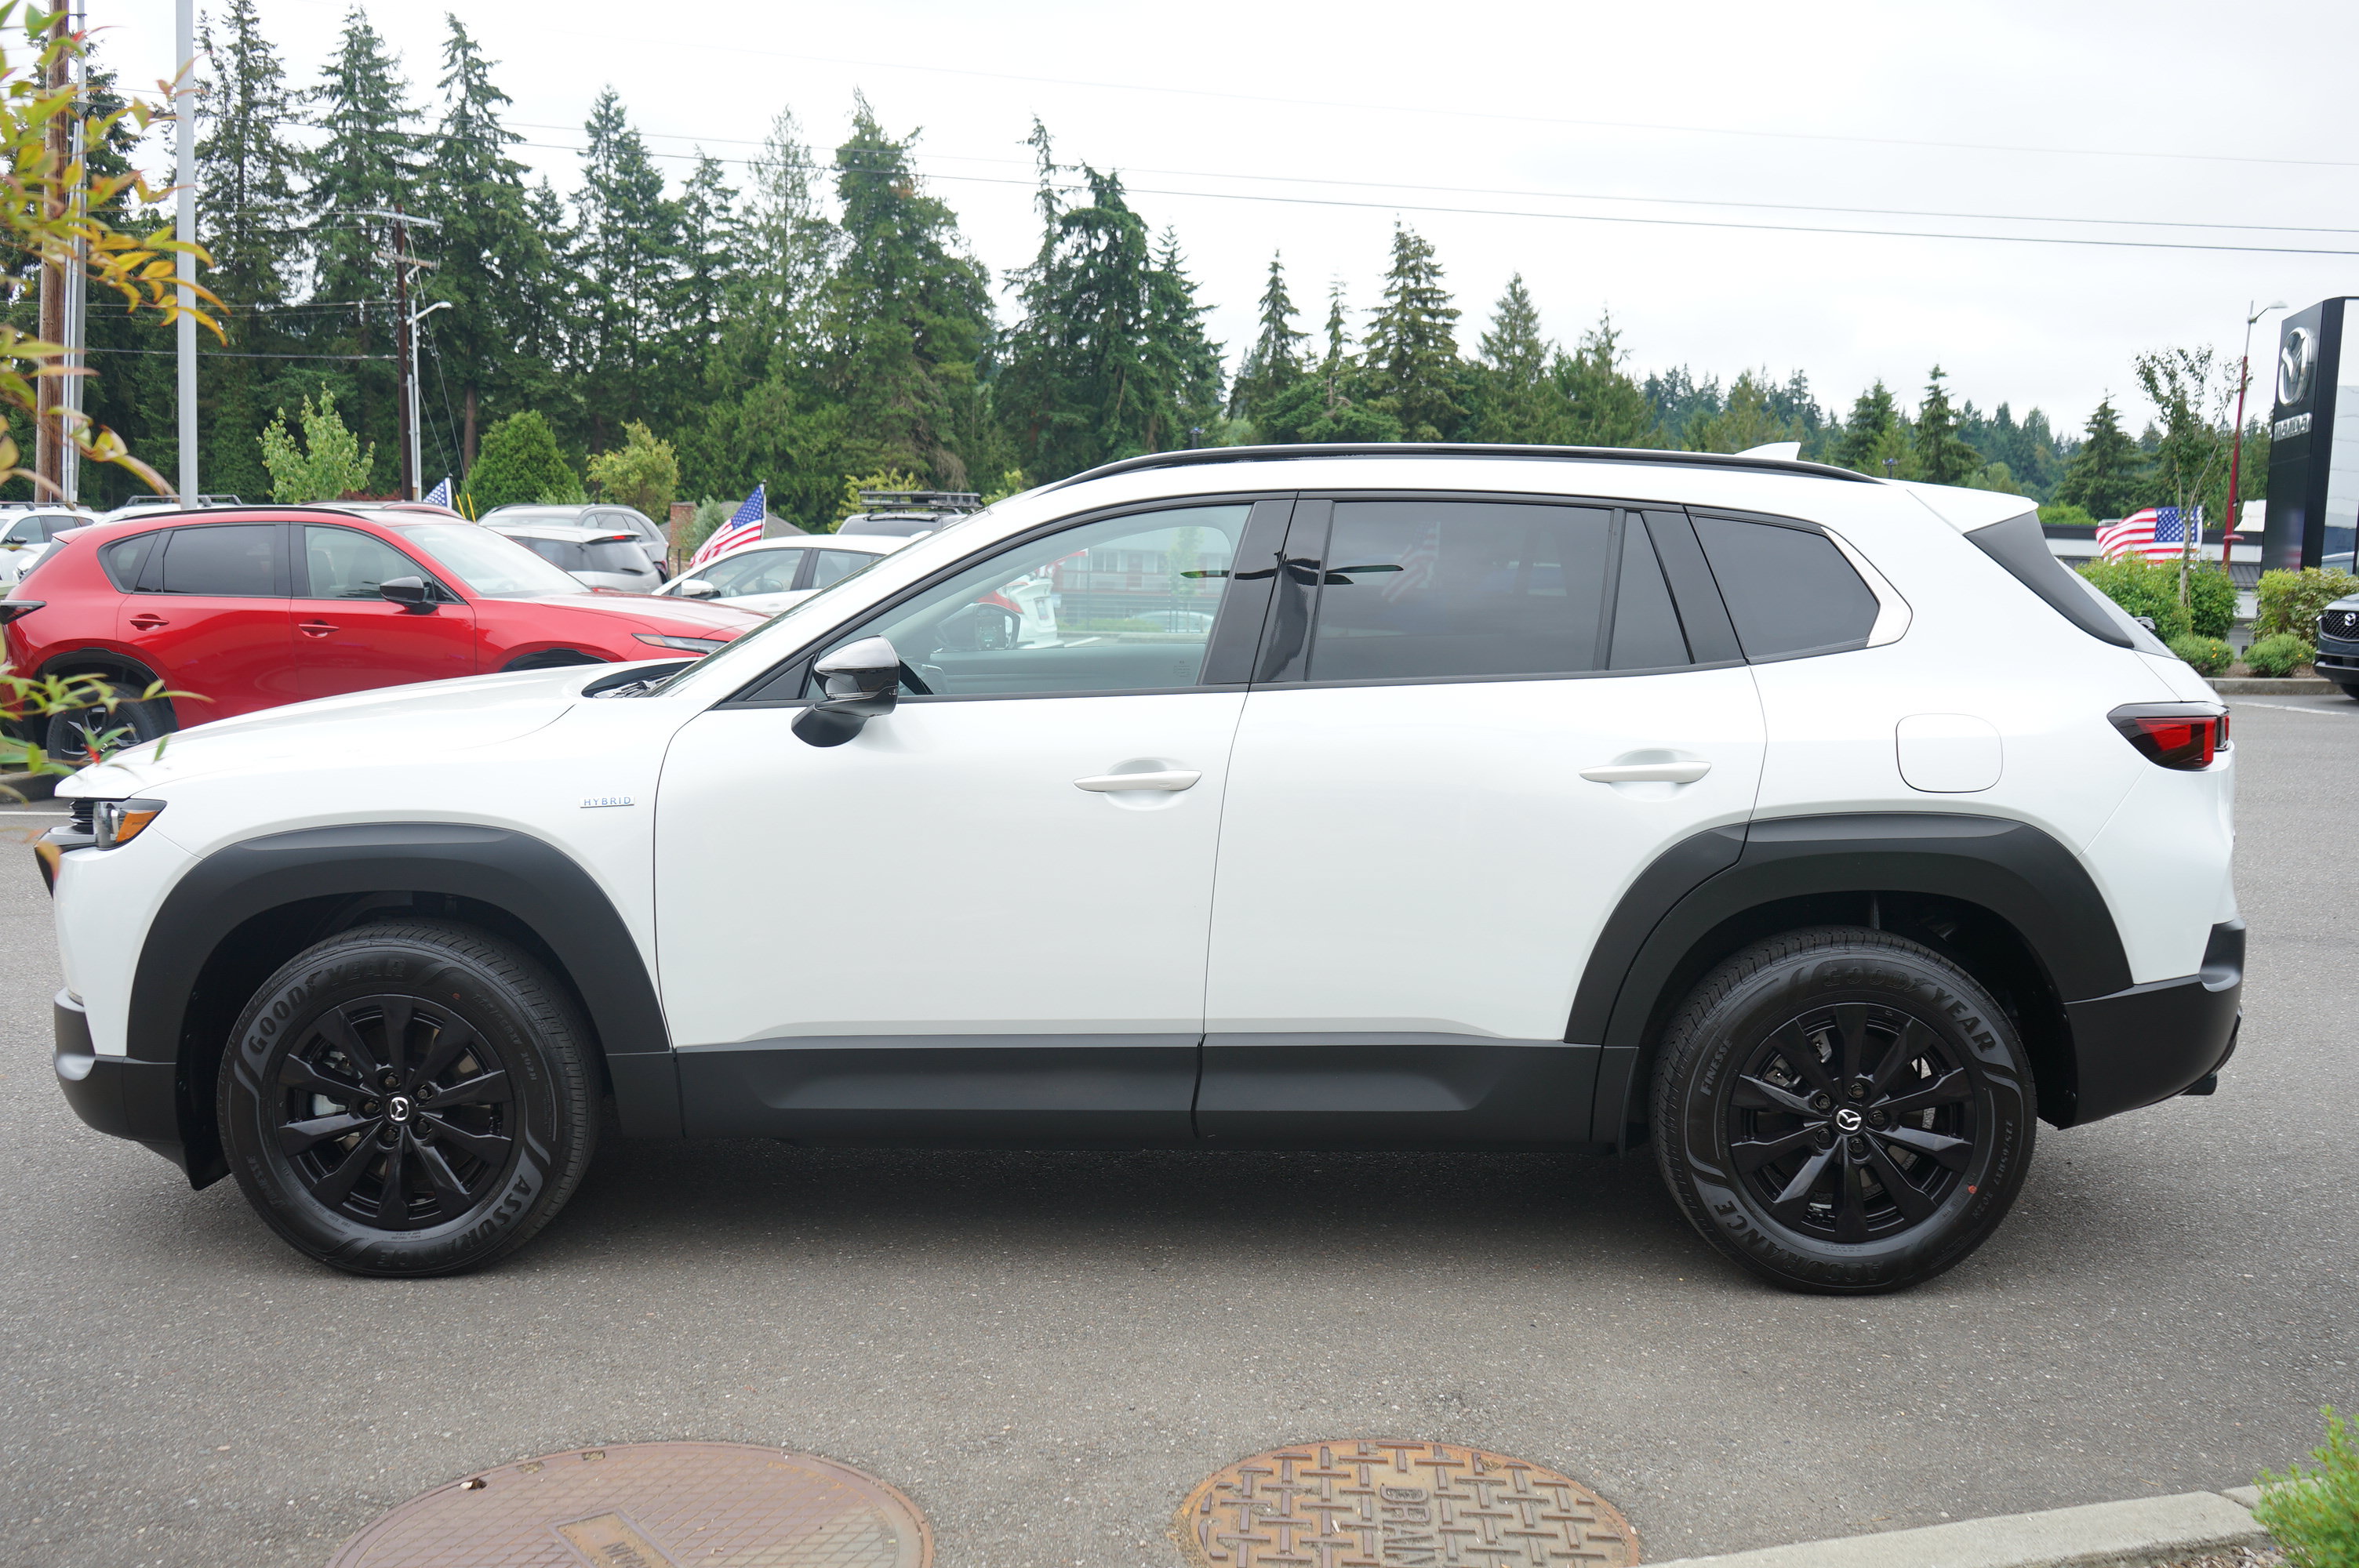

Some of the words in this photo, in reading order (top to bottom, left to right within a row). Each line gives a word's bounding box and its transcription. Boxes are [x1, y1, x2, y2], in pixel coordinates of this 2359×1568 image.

[583, 797, 631, 806] HYBRID
[376, 1174, 533, 1268] ASSURANCE
[1714, 1200, 1885, 1282] ASSURANCE
